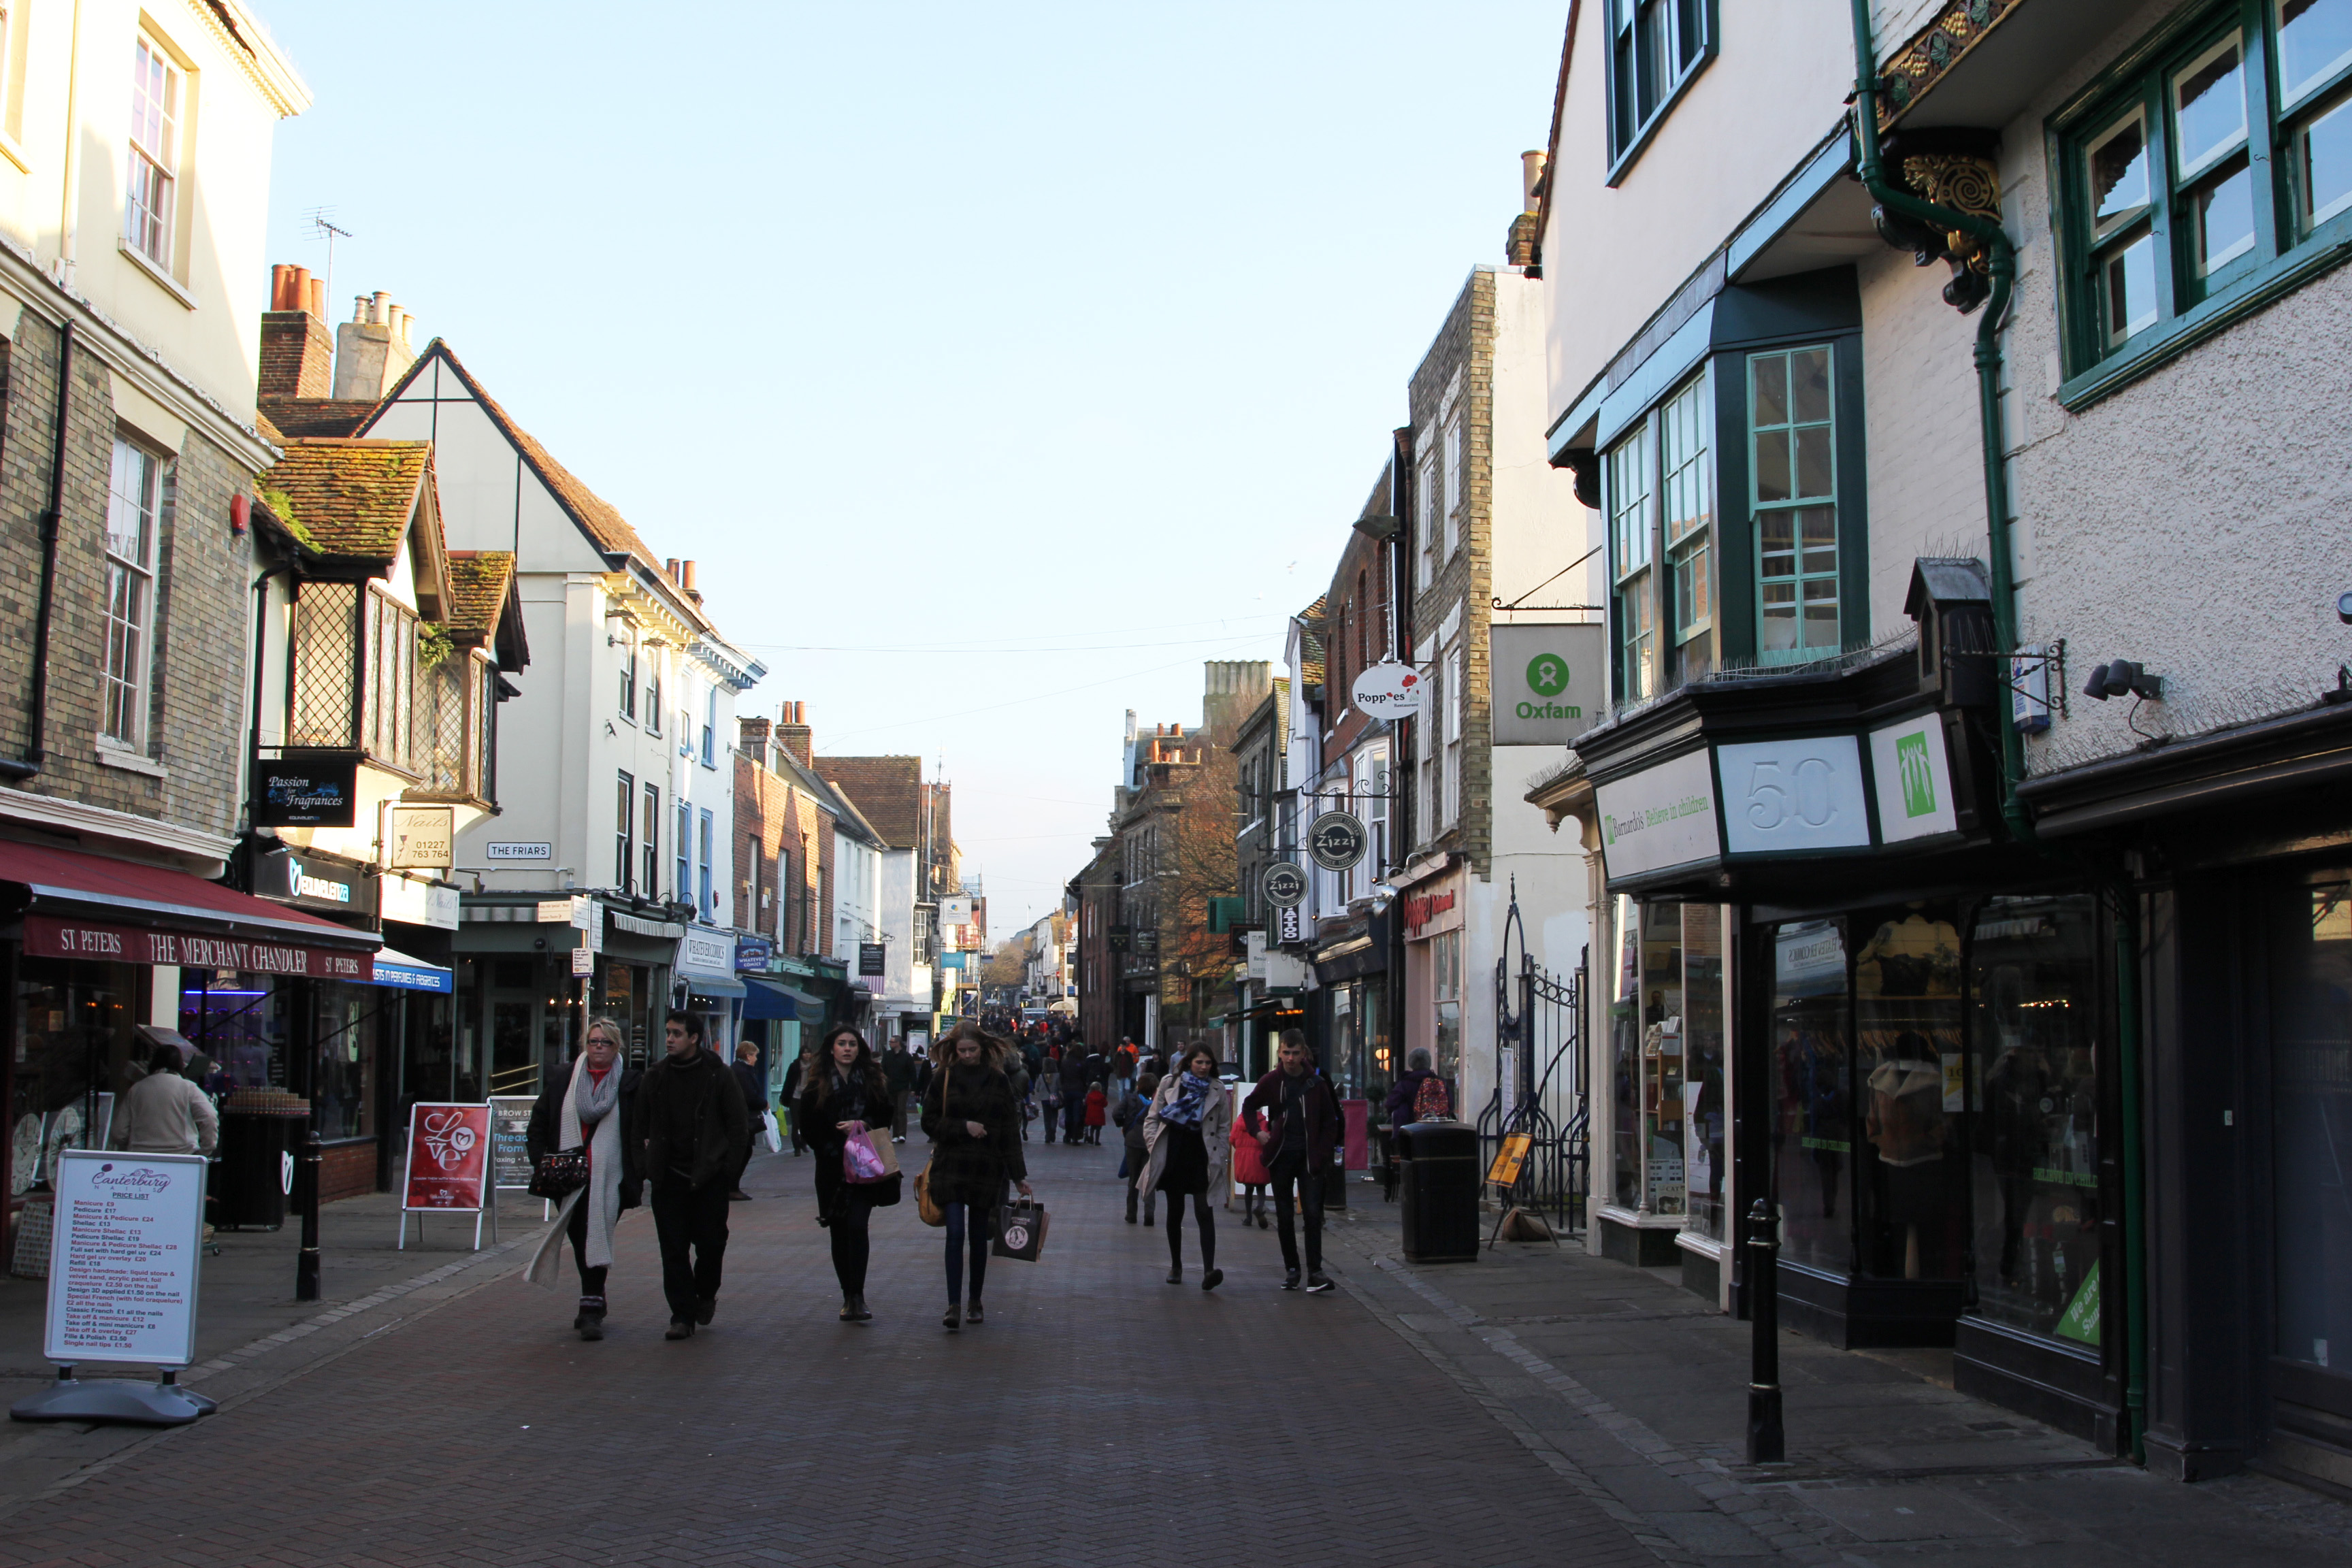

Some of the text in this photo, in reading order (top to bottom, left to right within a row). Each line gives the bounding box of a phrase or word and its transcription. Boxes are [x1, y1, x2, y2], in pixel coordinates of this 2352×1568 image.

[1516, 701, 1582, 719] Oxfam
[269, 777, 309, 787] Passion
[286, 787, 296, 796] for
[1746, 757, 1838, 831] 50
[286, 795, 343, 810] Fragrances
[395, 814, 450, 828] Nails
[1612, 795, 1709, 837] Barnardo's Believe in children
[1316, 835, 1356, 848] Zizzi
[412, 850, 449, 858] 763 764
[491, 847, 546, 855] THE FRIARS
[1269, 881, 1299, 890] Zizzi
[62, 929, 121, 953] ST PETERS
[689, 939, 725, 960] WHATEVER COMICS
[148, 934, 306, 974] THE MERCHANT CHANDLER
[325, 956, 359, 974] ST PETERS
[391, 970, 412, 984] PERFUMES
[416, 975, 440, 987] FRAGRANCES
[498, 1144, 523, 1152] From
[92, 1171, 172, 1193] Canterbury
[2033, 1167, 2063, 1183] BELIEVE
[2065, 1171, 2073, 1184] IN
[2070, 1279, 2097, 1322] We are
